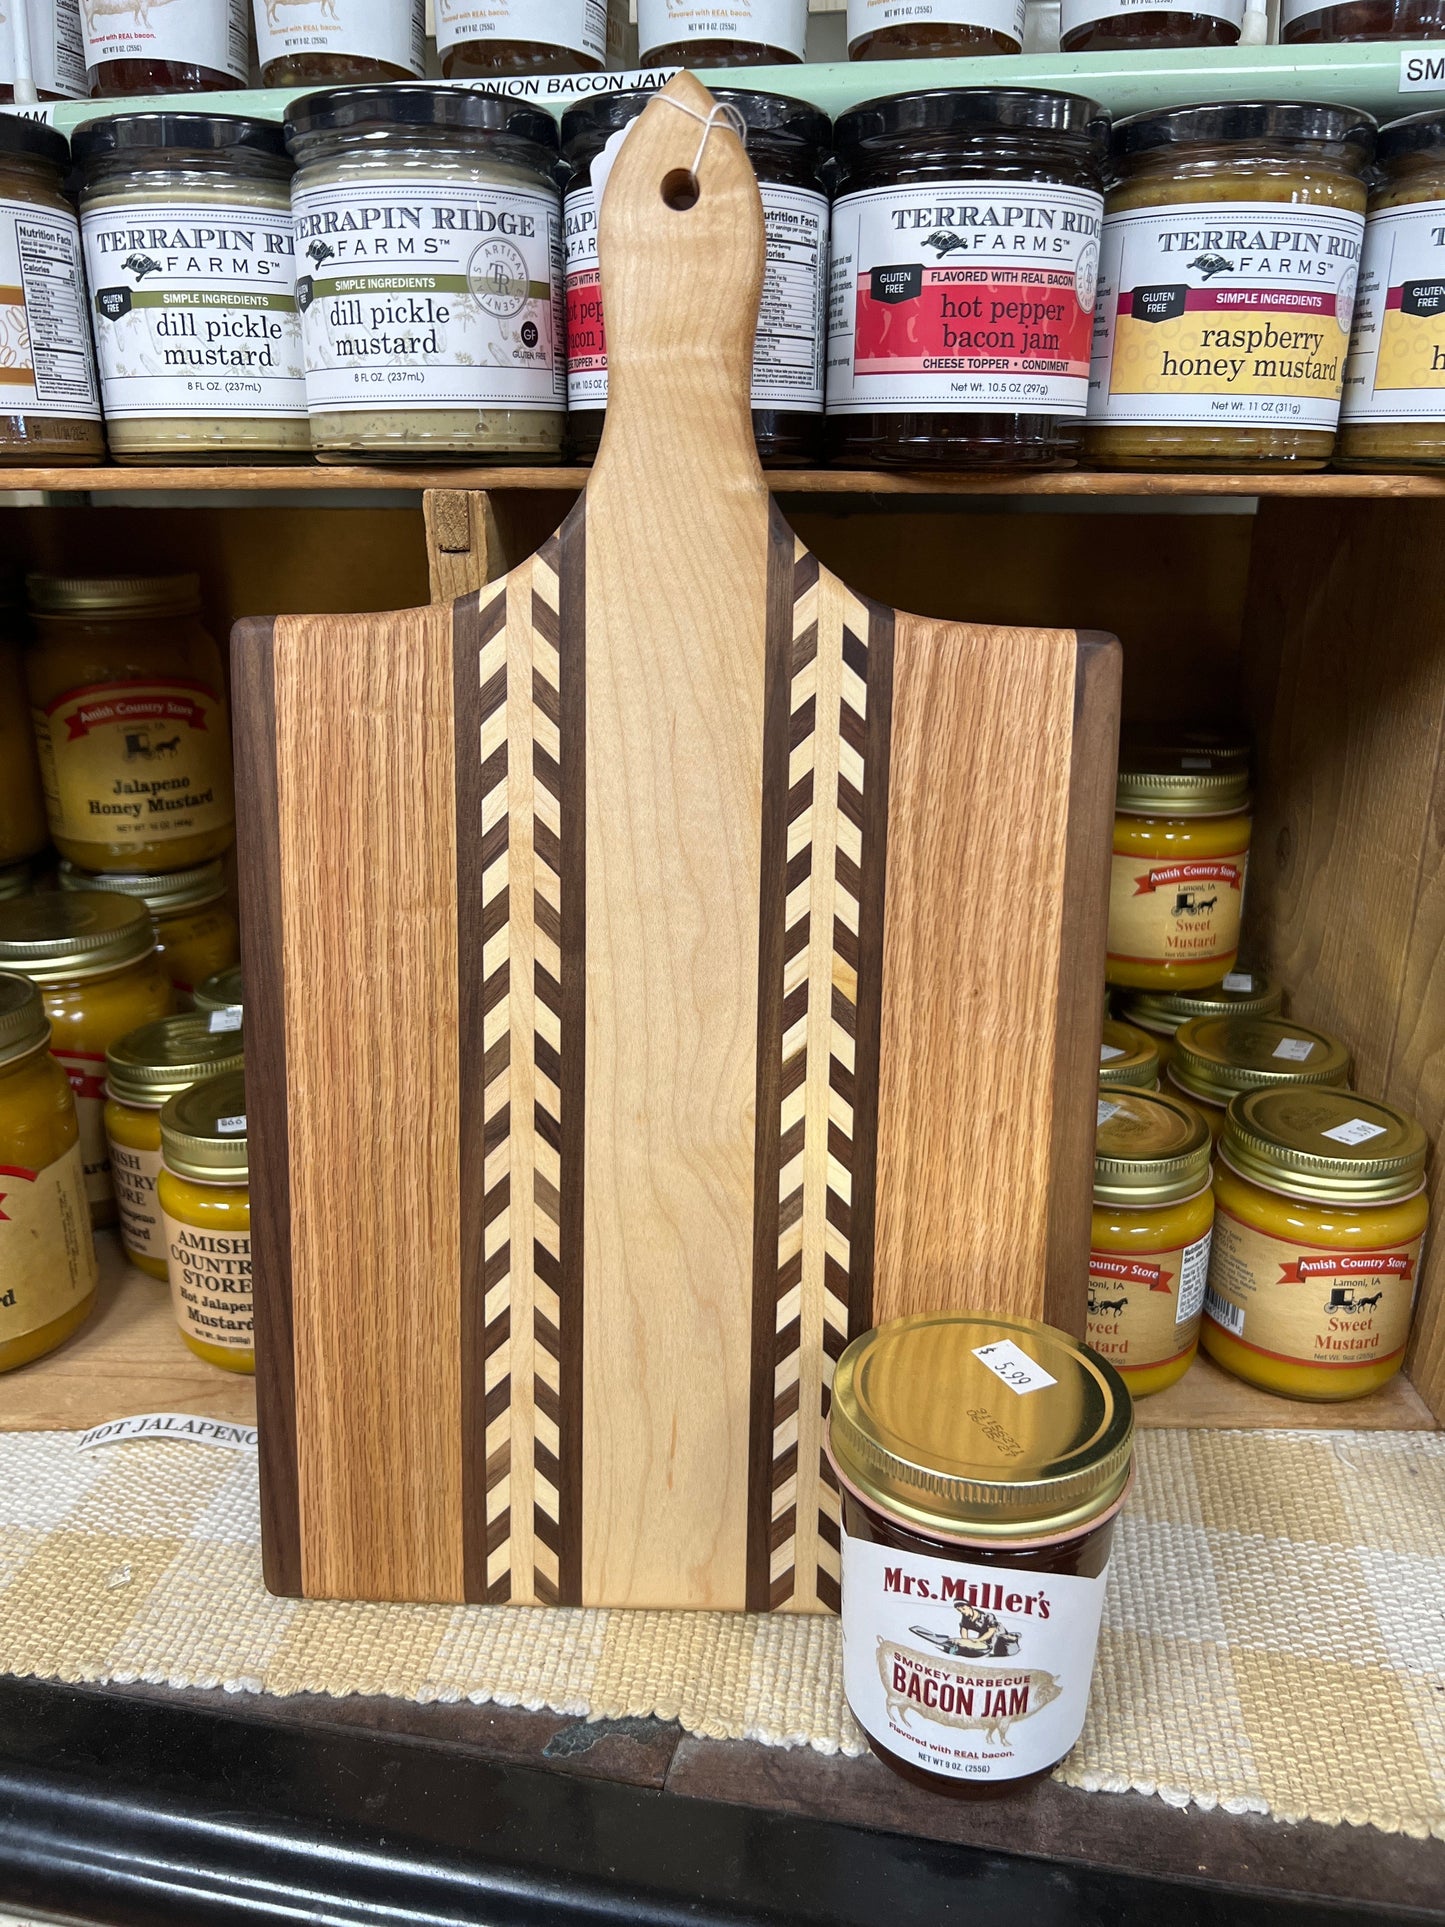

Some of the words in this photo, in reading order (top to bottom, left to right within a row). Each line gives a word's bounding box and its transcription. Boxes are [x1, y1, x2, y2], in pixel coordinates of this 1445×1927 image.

[303, 24, 320, 32] REAL
[688, 23, 698, 31] NET
[547, 76, 624, 93] BACON
[432, 207, 535, 238] RIDGE
[764, 210, 798, 225] utrition
[800, 214, 818, 229] Facts
[891, 206, 1057, 230] TERRAPIN
[1060, 210, 1100, 237] RIDG
[19, 226, 55, 242] Nutrition
[56, 233, 72, 247] Facts
[97, 228, 257, 254] TERRAPIN
[766, 249, 785, 259] lories
[1158, 230, 1322, 253] TERRAPIN
[1327, 235, 1361, 262] RIDG
[23, 263, 50, 274] Calories
[335, 279, 366, 292] SIMPLE
[367, 277, 436, 290] INGREDIENTS
[578, 272, 594, 285] WITH
[879, 272, 911, 283] GLUTEN
[930, 271, 988, 282] FLAVORED
[991, 272, 1019, 283] WITH
[1020, 272, 1046, 284] REAL
[1047, 274, 1073, 287] BACON
[885, 283, 905, 294] FREE
[102, 293, 124, 305] GLUTEN
[163, 294, 200, 304] SIMPLE
[202, 294, 269, 306] INGREDIENTS
[1142, 292, 1175, 303] GLUTEN
[1216, 292, 1258, 304] SIMPLE
[1260, 294, 1323, 307] INGREDIENTS
[1417, 297, 1439, 308] FREE
[107, 304, 120, 313] FREE
[330, 299, 363, 326] dill
[370, 298, 450, 329] pickle
[941, 294, 983, 318] hot
[990, 300, 1064, 324] pepper
[1147, 302, 1167, 313] FREE
[156, 313, 198, 337] dill
[205, 313, 283, 342] pickle
[523, 329, 536, 340] GF
[336, 329, 439, 356] mustard
[943, 323, 1015, 348] bacon
[1020, 326, 1060, 354] jam
[1200, 322, 1324, 356] raspberry
[164, 344, 274, 367] mustard
[576, 357, 593, 369] TOPPER
[922, 359, 965, 369] CHEESE
[968, 359, 1009, 369] TOPPER
[1021, 359, 1070, 371] CONDIMENT
[1160, 351, 1246, 382] honey
[1252, 356, 1338, 382] mustard
[354, 373, 360, 382] 8
[361, 374, 370, 382] FL
[371, 373, 385, 382] OZ.
[387, 372, 425, 383] (237mL)
[187, 382, 194, 391] 8
[195, 383, 205, 391] FL
[206, 382, 222, 392] OZ.
[225, 381, 262, 393] (237mL)
[950, 382, 966, 392] Net
[970, 383, 985, 393] Wt.
[988, 383, 1007, 392] 10.5
[1008, 383, 1021, 392] OZ
[1023, 383, 1049, 396] (297g)
[1211, 400, 1227, 411] Net
[1229, 401, 1245, 411] Wt.
[1247, 401, 1259, 411] 11
[1260, 401, 1274, 411] OZ
[1275, 401, 1301, 415] (311g)
[80, 703, 114, 724] Amish
[116, 700, 165, 716] Country
[113, 776, 191, 797] Jalapeno
[88, 798, 142, 818] Honey
[148, 788, 214, 814] Mustard
[1150, 865, 1180, 883] Amish
[1183, 864, 1219, 877] Country
[1219, 864, 1237, 877] Store
[1175, 918, 1211, 933] Sweet
[1165, 934, 1217, 950] Mustard
[178, 1230, 250, 1255] AMISH
[170, 1246, 252, 1275] COUNTR
[1299, 1259, 1337, 1272] Amish
[1340, 1257, 1385, 1270] Country
[1386, 1257, 1407, 1269] Store
[1089, 1260, 1128, 1275] ountry
[1131, 1264, 1160, 1279] Store
[183, 1268, 253, 1295] STORE
[1113, 1281, 1125, 1290] IA
[1371, 1277, 1381, 1286] IA
[180, 1286, 198, 1305] Hot
[188, 1306, 255, 1331] Mustard
[1328, 1317, 1373, 1332] Sweet
[1087, 1322, 1120, 1335] weet
[1088, 1340, 1129, 1354] stard
[1314, 1333, 1379, 1351] Mustard
[1314, 1353, 1328, 1361] Net
[994, 1360, 1032, 1386] 5.99
[78, 1420, 131, 1447] HOT
[893, 1651, 951, 1681] SMOKEY
[956, 1674, 1031, 1688] BARBECUE
[892, 1662, 975, 1718] BACON
[981, 1685, 1030, 1718] JAM
[888, 1721, 928, 1748] Flavored
[929, 1743, 952, 1755] with
[953, 1749, 980, 1760] REAL
[981, 1750, 1015, 1759] bacon.
[918, 1751, 932, 1763] NET
[932, 1757, 944, 1767] WT
[944, 1761, 950, 1769] 9
[951, 1761, 964, 1771] OZ.
[965, 1763, 991, 1773] (255G)
